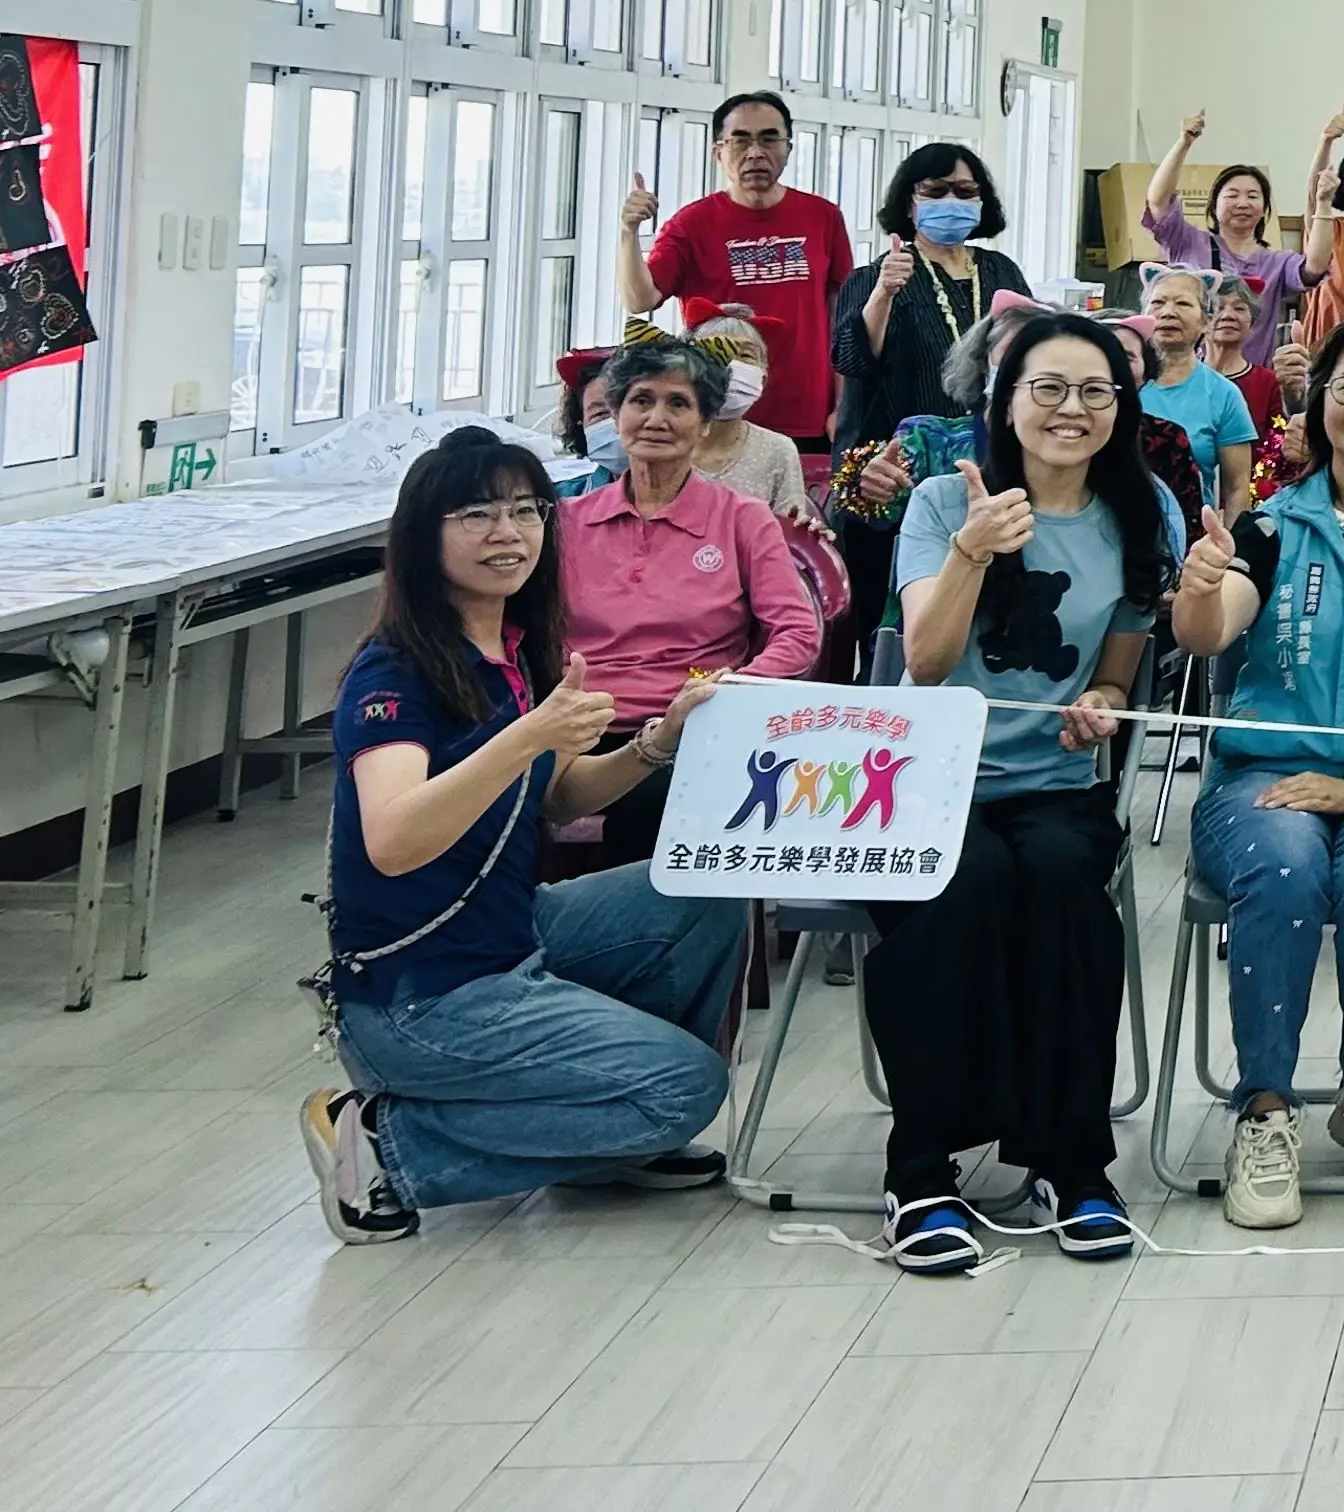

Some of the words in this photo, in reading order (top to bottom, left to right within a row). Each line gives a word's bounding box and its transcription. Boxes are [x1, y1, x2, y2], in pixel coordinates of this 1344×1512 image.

[765, 704, 914, 743] 全齡多元樂學
[665, 843, 943, 876] 全齡多元樂學發展協會
